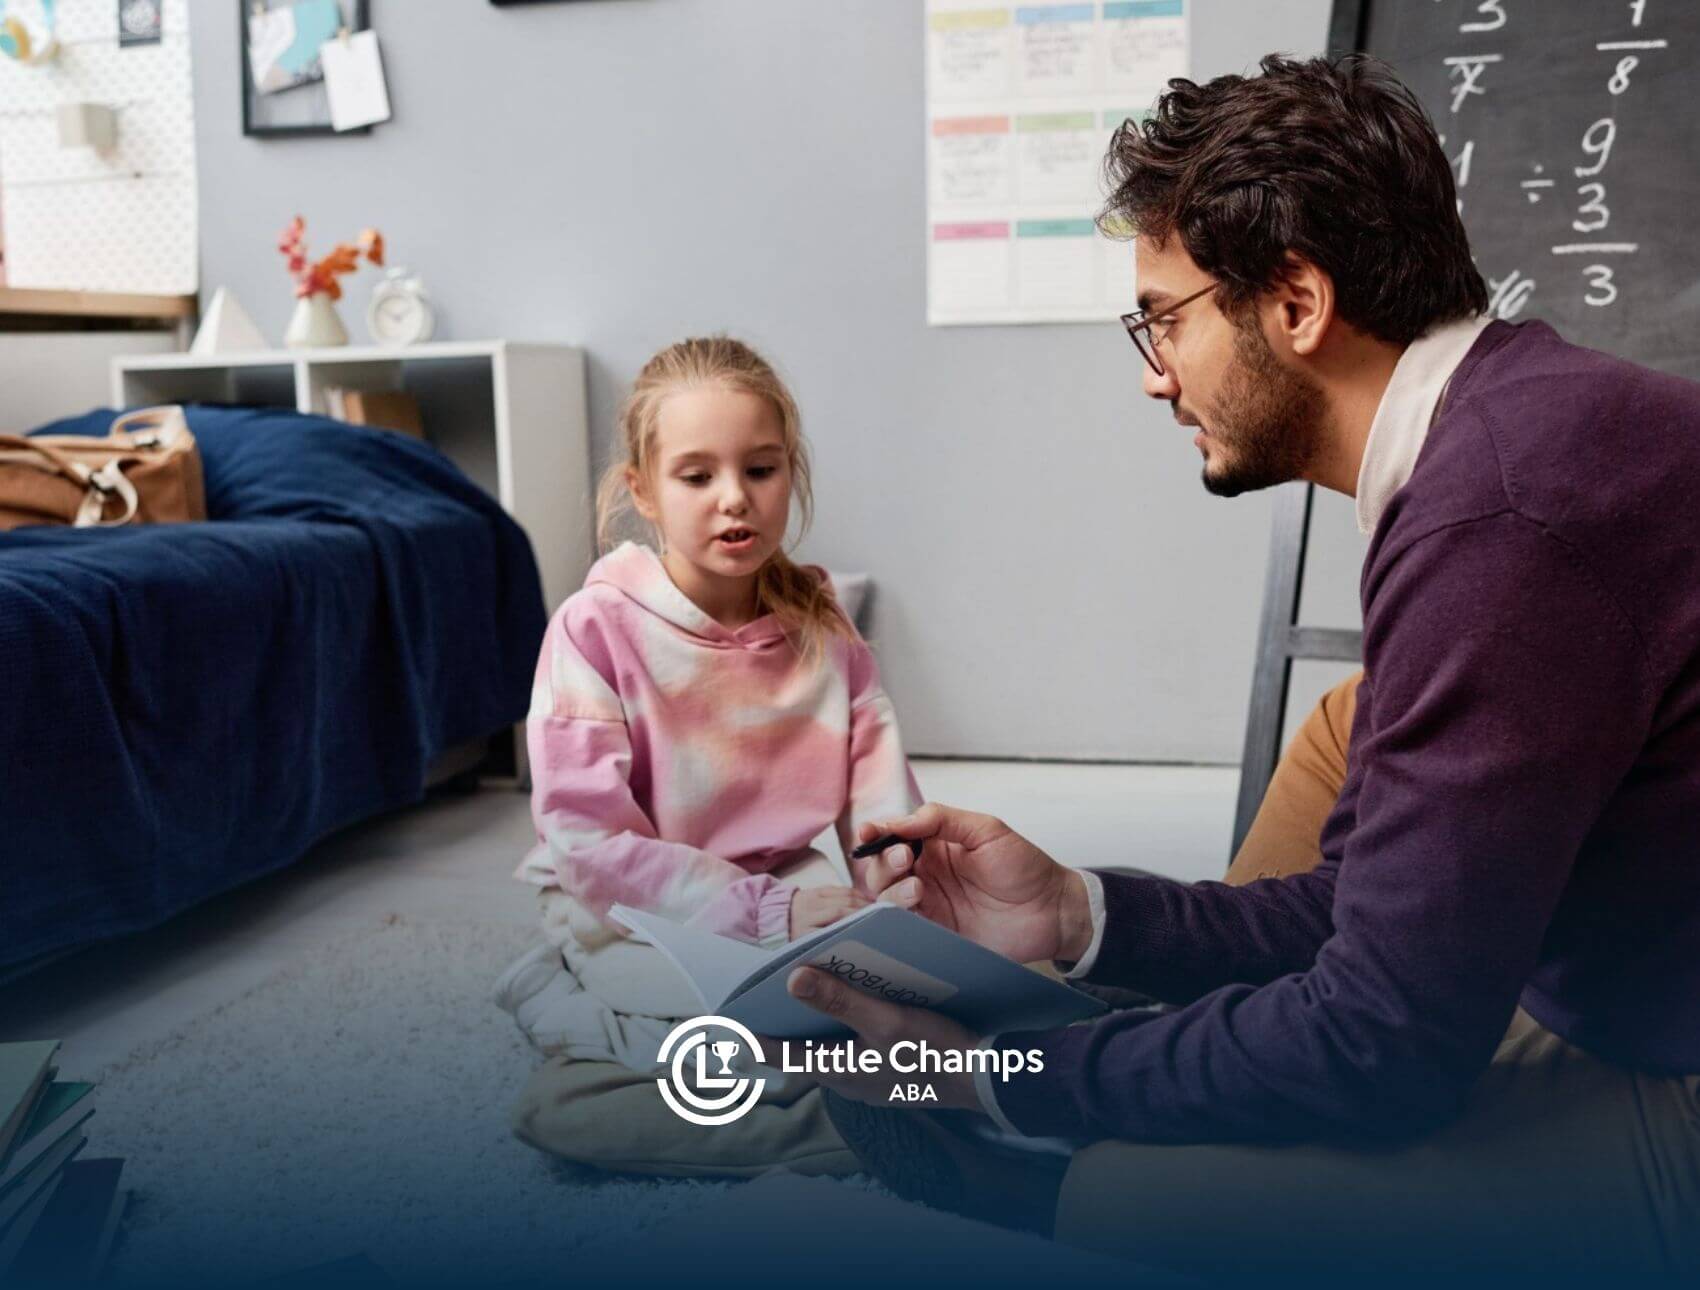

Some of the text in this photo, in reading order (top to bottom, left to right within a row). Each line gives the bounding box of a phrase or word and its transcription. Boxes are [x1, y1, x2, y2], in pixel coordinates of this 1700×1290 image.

[1607, 55, 1639, 95] 8
[1574, 117, 1616, 178] 9
[1572, 182, 1610, 232] 3
[1582, 264, 1618, 306] 3
